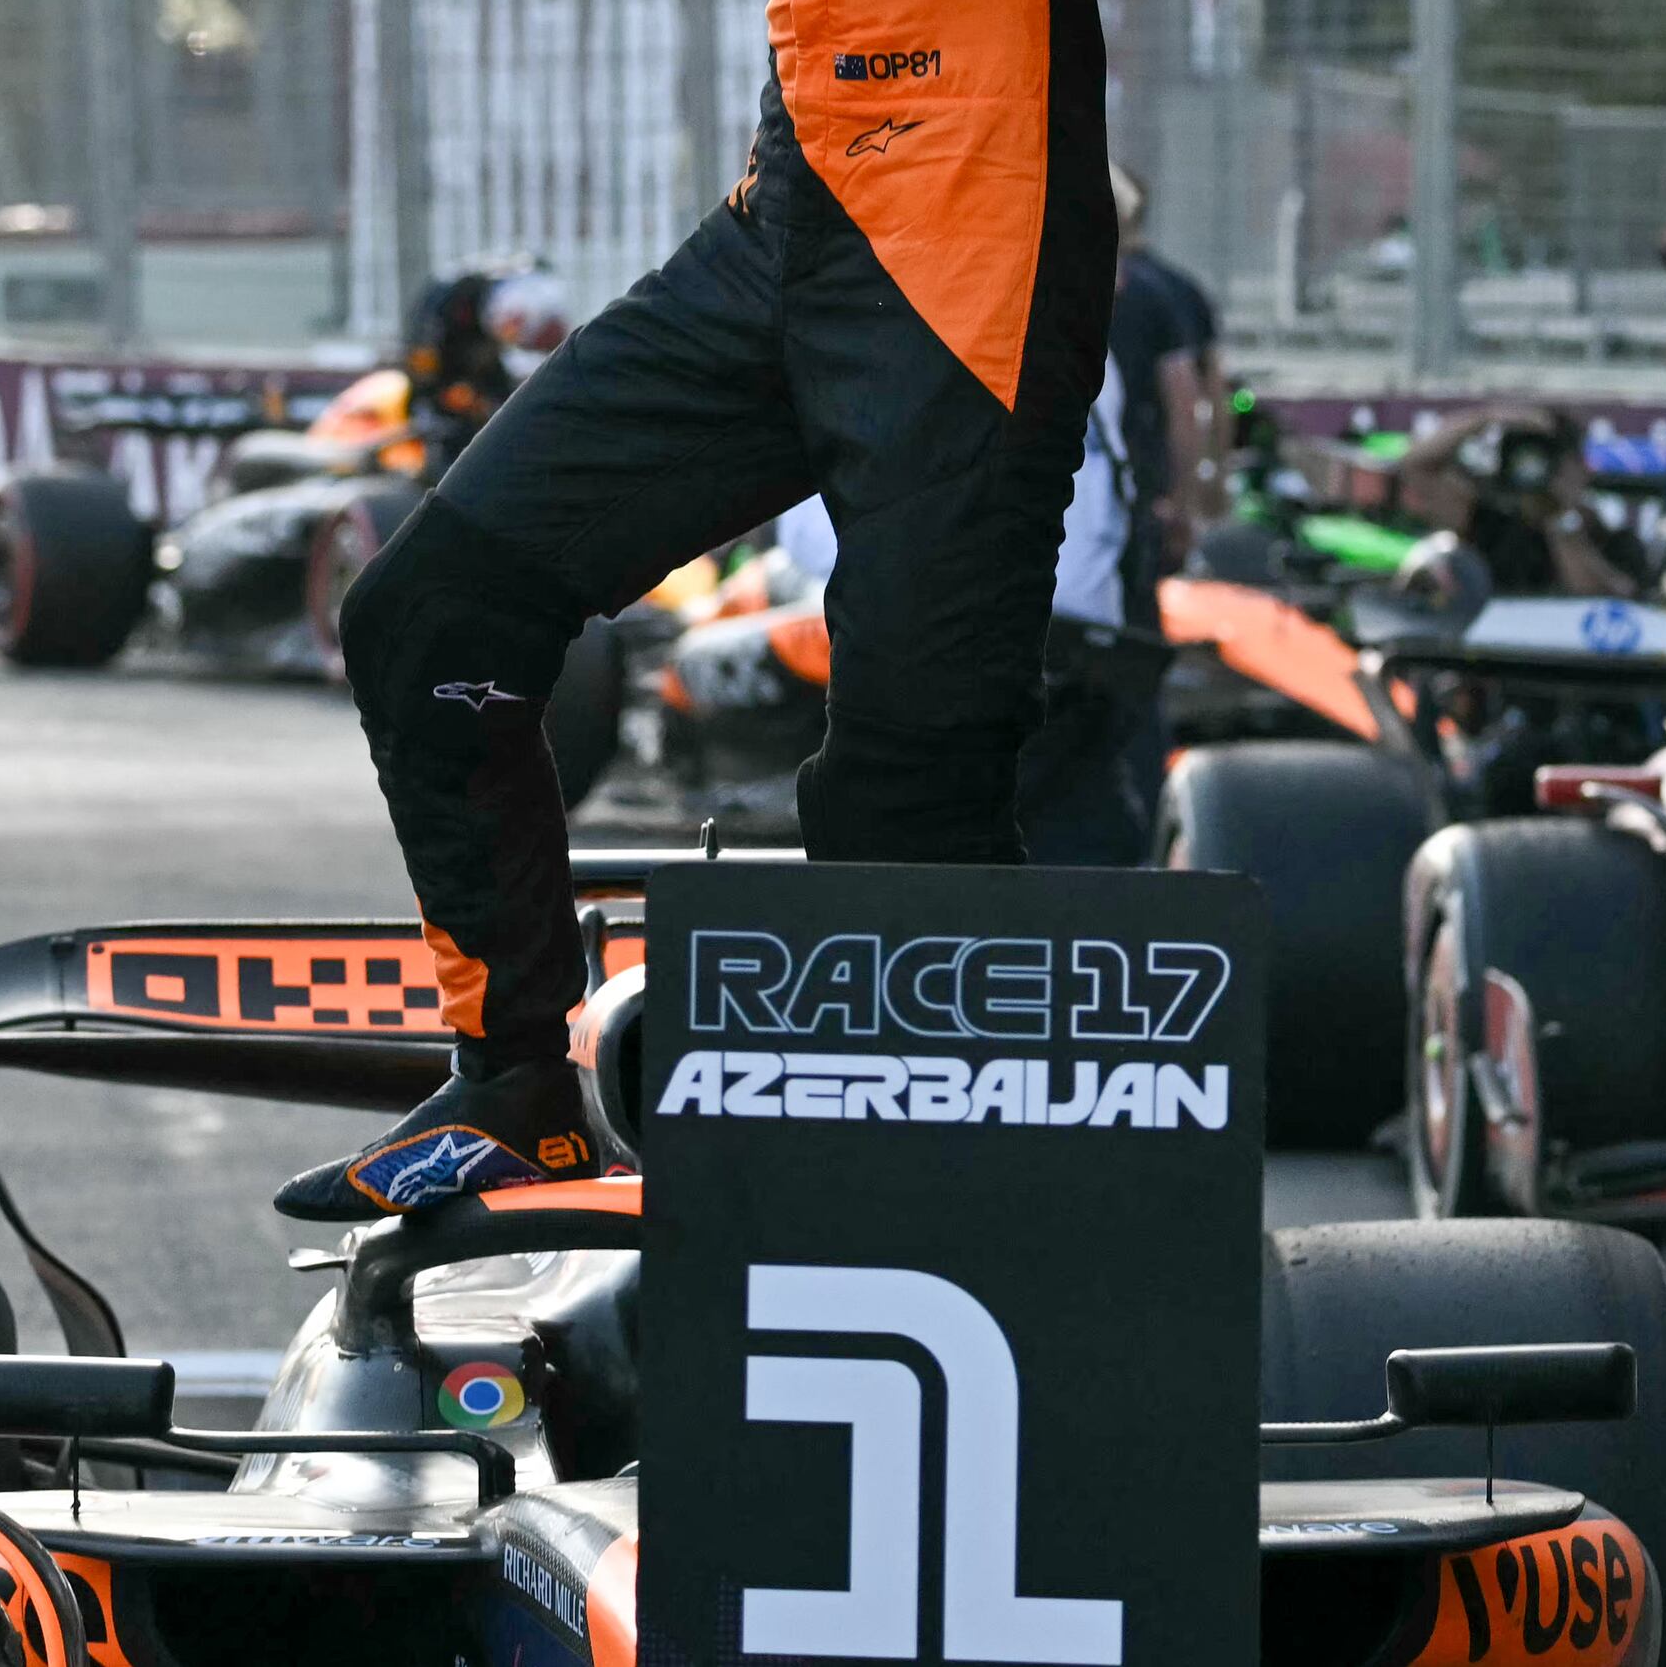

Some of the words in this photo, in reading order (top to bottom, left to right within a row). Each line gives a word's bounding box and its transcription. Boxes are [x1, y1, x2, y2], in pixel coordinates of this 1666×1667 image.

[869, 49, 941, 81] OP81
[689, 930, 1052, 1040] RACE
[1071, 939, 1231, 1042] 17
[655, 1049, 1230, 1131] AZERBAIJAN
[742, 1264, 1123, 1667] 1
[1259, 1522, 1399, 1535] ware
[503, 1541, 553, 1611] RICHARD
[554, 1578, 586, 1639] MILLE
